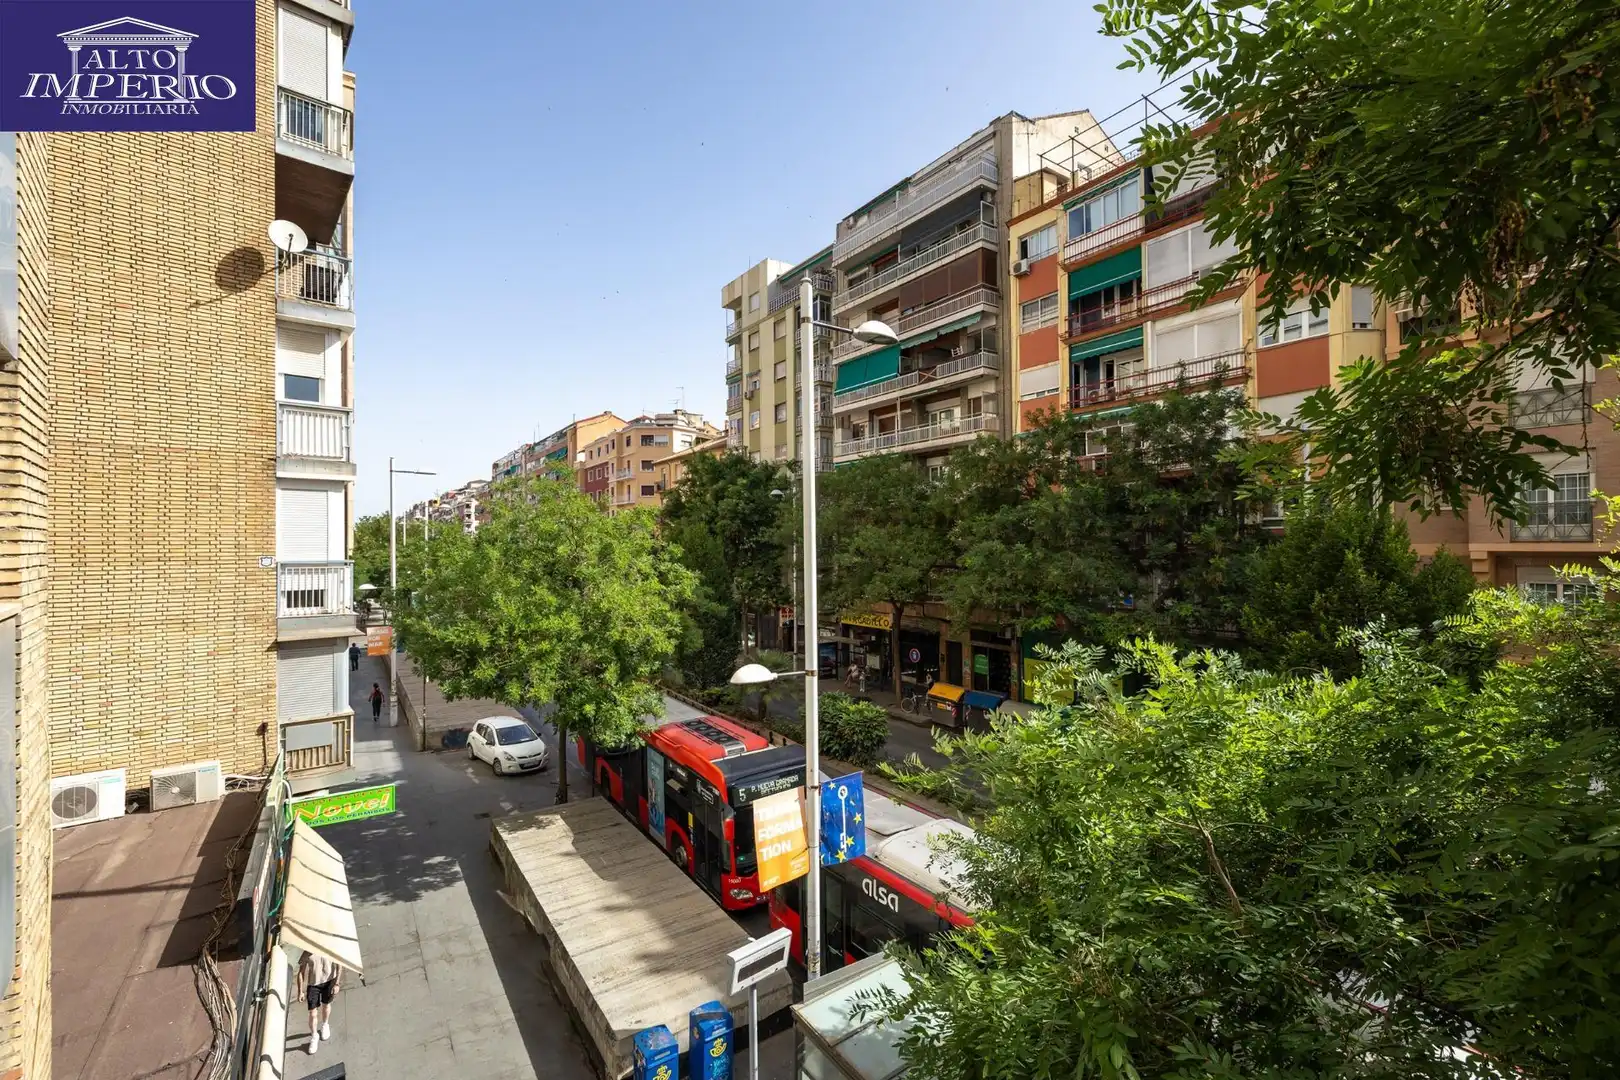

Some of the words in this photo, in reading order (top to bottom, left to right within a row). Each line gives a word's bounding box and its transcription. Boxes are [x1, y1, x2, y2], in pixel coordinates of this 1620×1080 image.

[738, 788, 747, 802] 5
[327, 814, 344, 823] LOS
[346, 806, 391, 819] PERMISOS
[758, 839, 792, 862] TION
[862, 877, 899, 913] alsa
